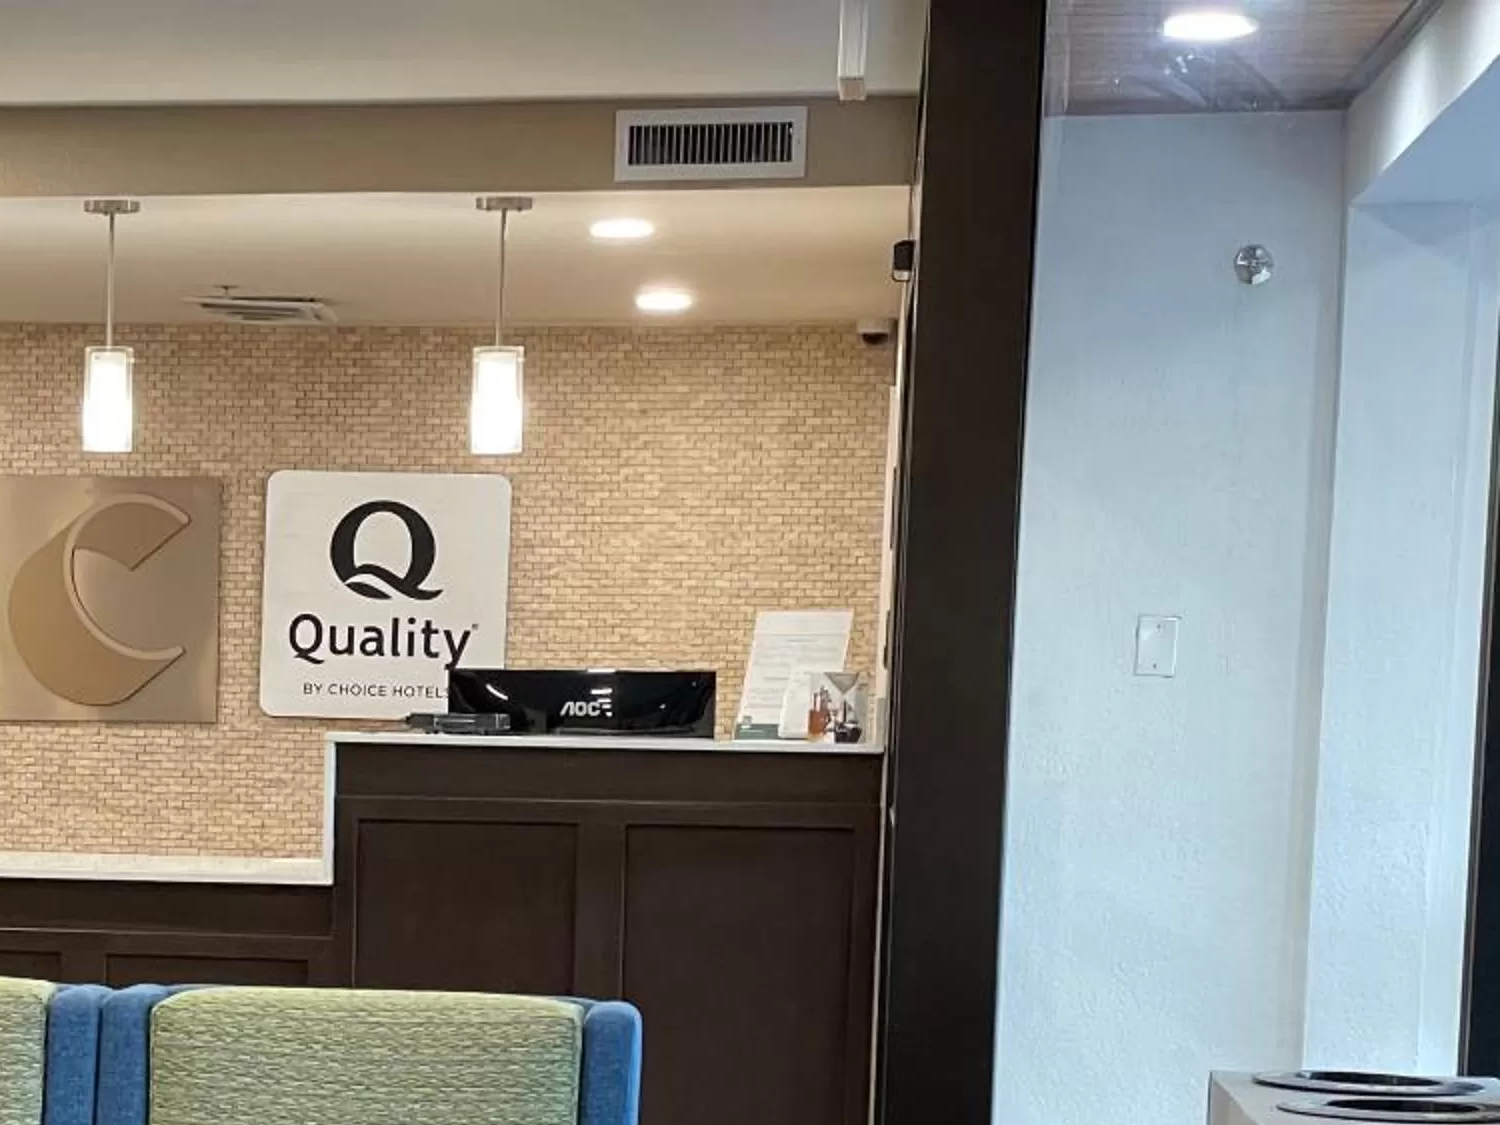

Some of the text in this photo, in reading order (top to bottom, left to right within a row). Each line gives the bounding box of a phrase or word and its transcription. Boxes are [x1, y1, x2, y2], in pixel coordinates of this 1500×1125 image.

[330, 500, 443, 600] Q
[289, 613, 471, 670] Quality
[303, 683, 323, 695] BY
[328, 683, 387, 697] CHOICE
[560, 701, 601, 717] AOC
